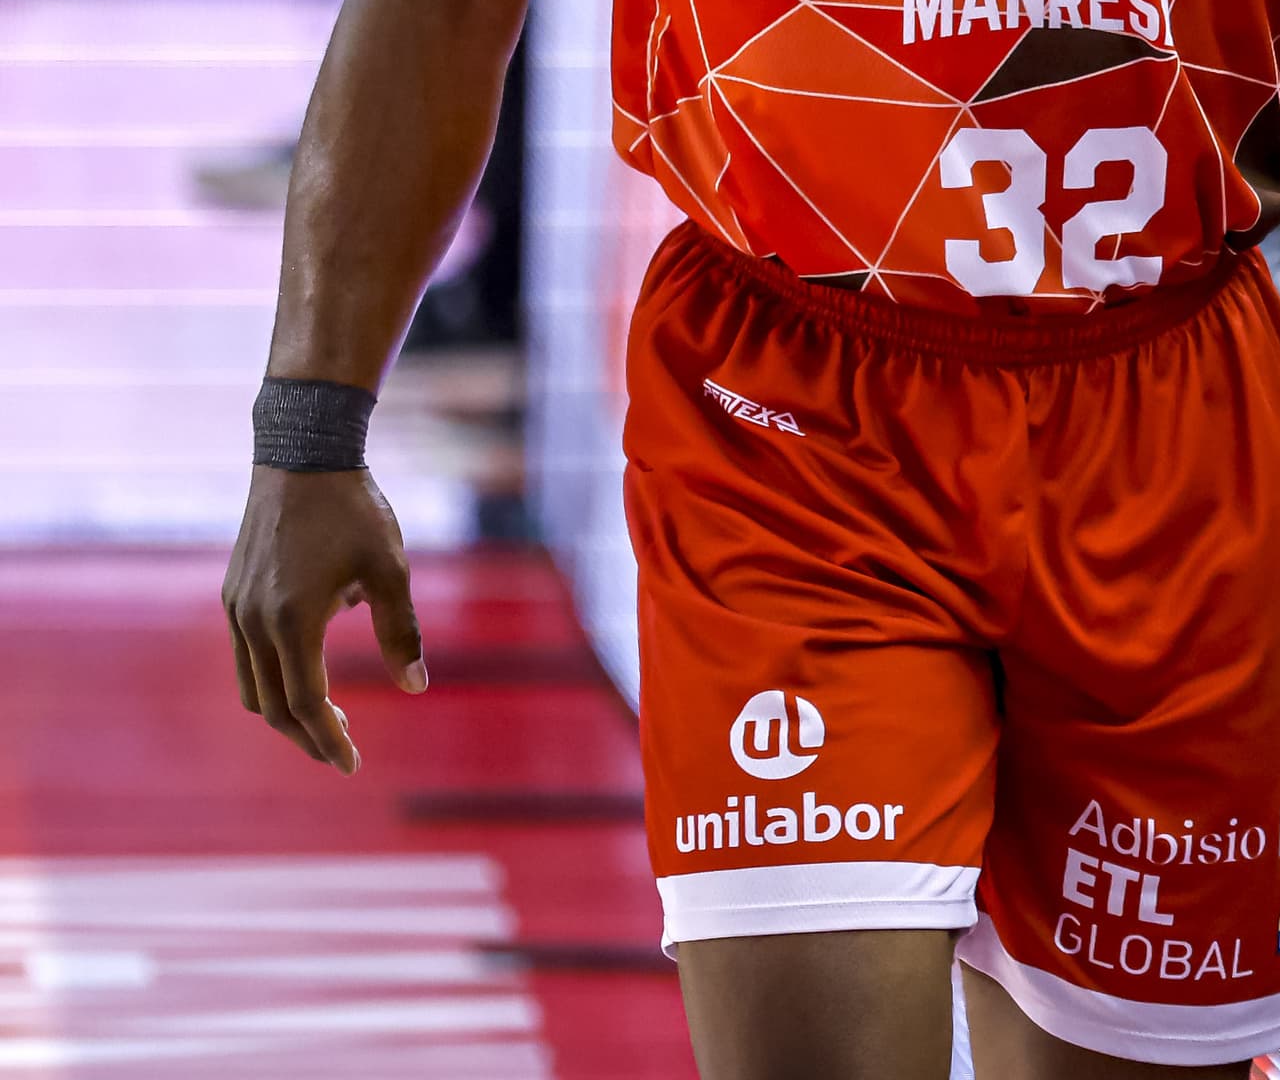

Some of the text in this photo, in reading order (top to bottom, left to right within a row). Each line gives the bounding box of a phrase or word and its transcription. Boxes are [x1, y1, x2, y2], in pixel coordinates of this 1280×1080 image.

[939, 125, 1168, 298] 32
[675, 792, 904, 854] unilabor
[1068, 799, 1267, 867] Adbisio
[1062, 848, 1175, 926] ETL
[1054, 912, 1254, 981] GLOBAL
